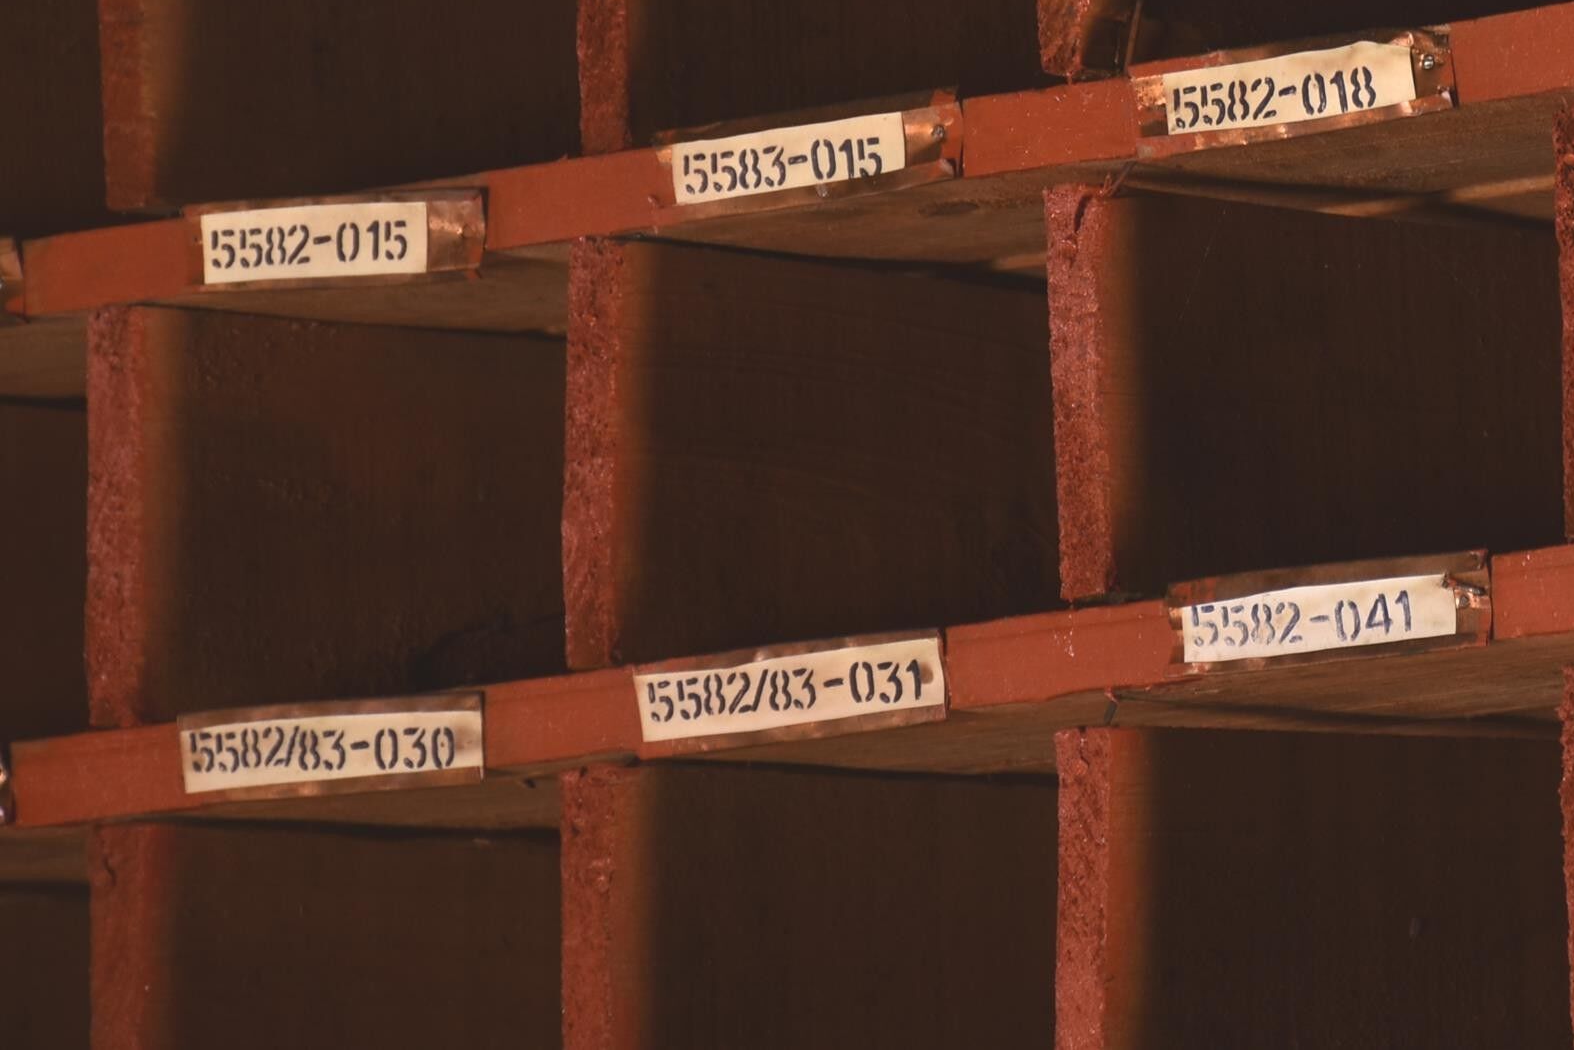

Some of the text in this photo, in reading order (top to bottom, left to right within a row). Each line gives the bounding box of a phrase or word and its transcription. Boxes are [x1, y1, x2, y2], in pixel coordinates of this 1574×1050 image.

[1172, 66, 1377, 129] 5582-018
[682, 137, 884, 194] 5583-015
[211, 220, 408, 269] 5582-015
[1190, 590, 1413, 648] 5582-041
[647, 659, 922, 723] 5582/83-031
[189, 725, 456, 774] 5582/83-030
